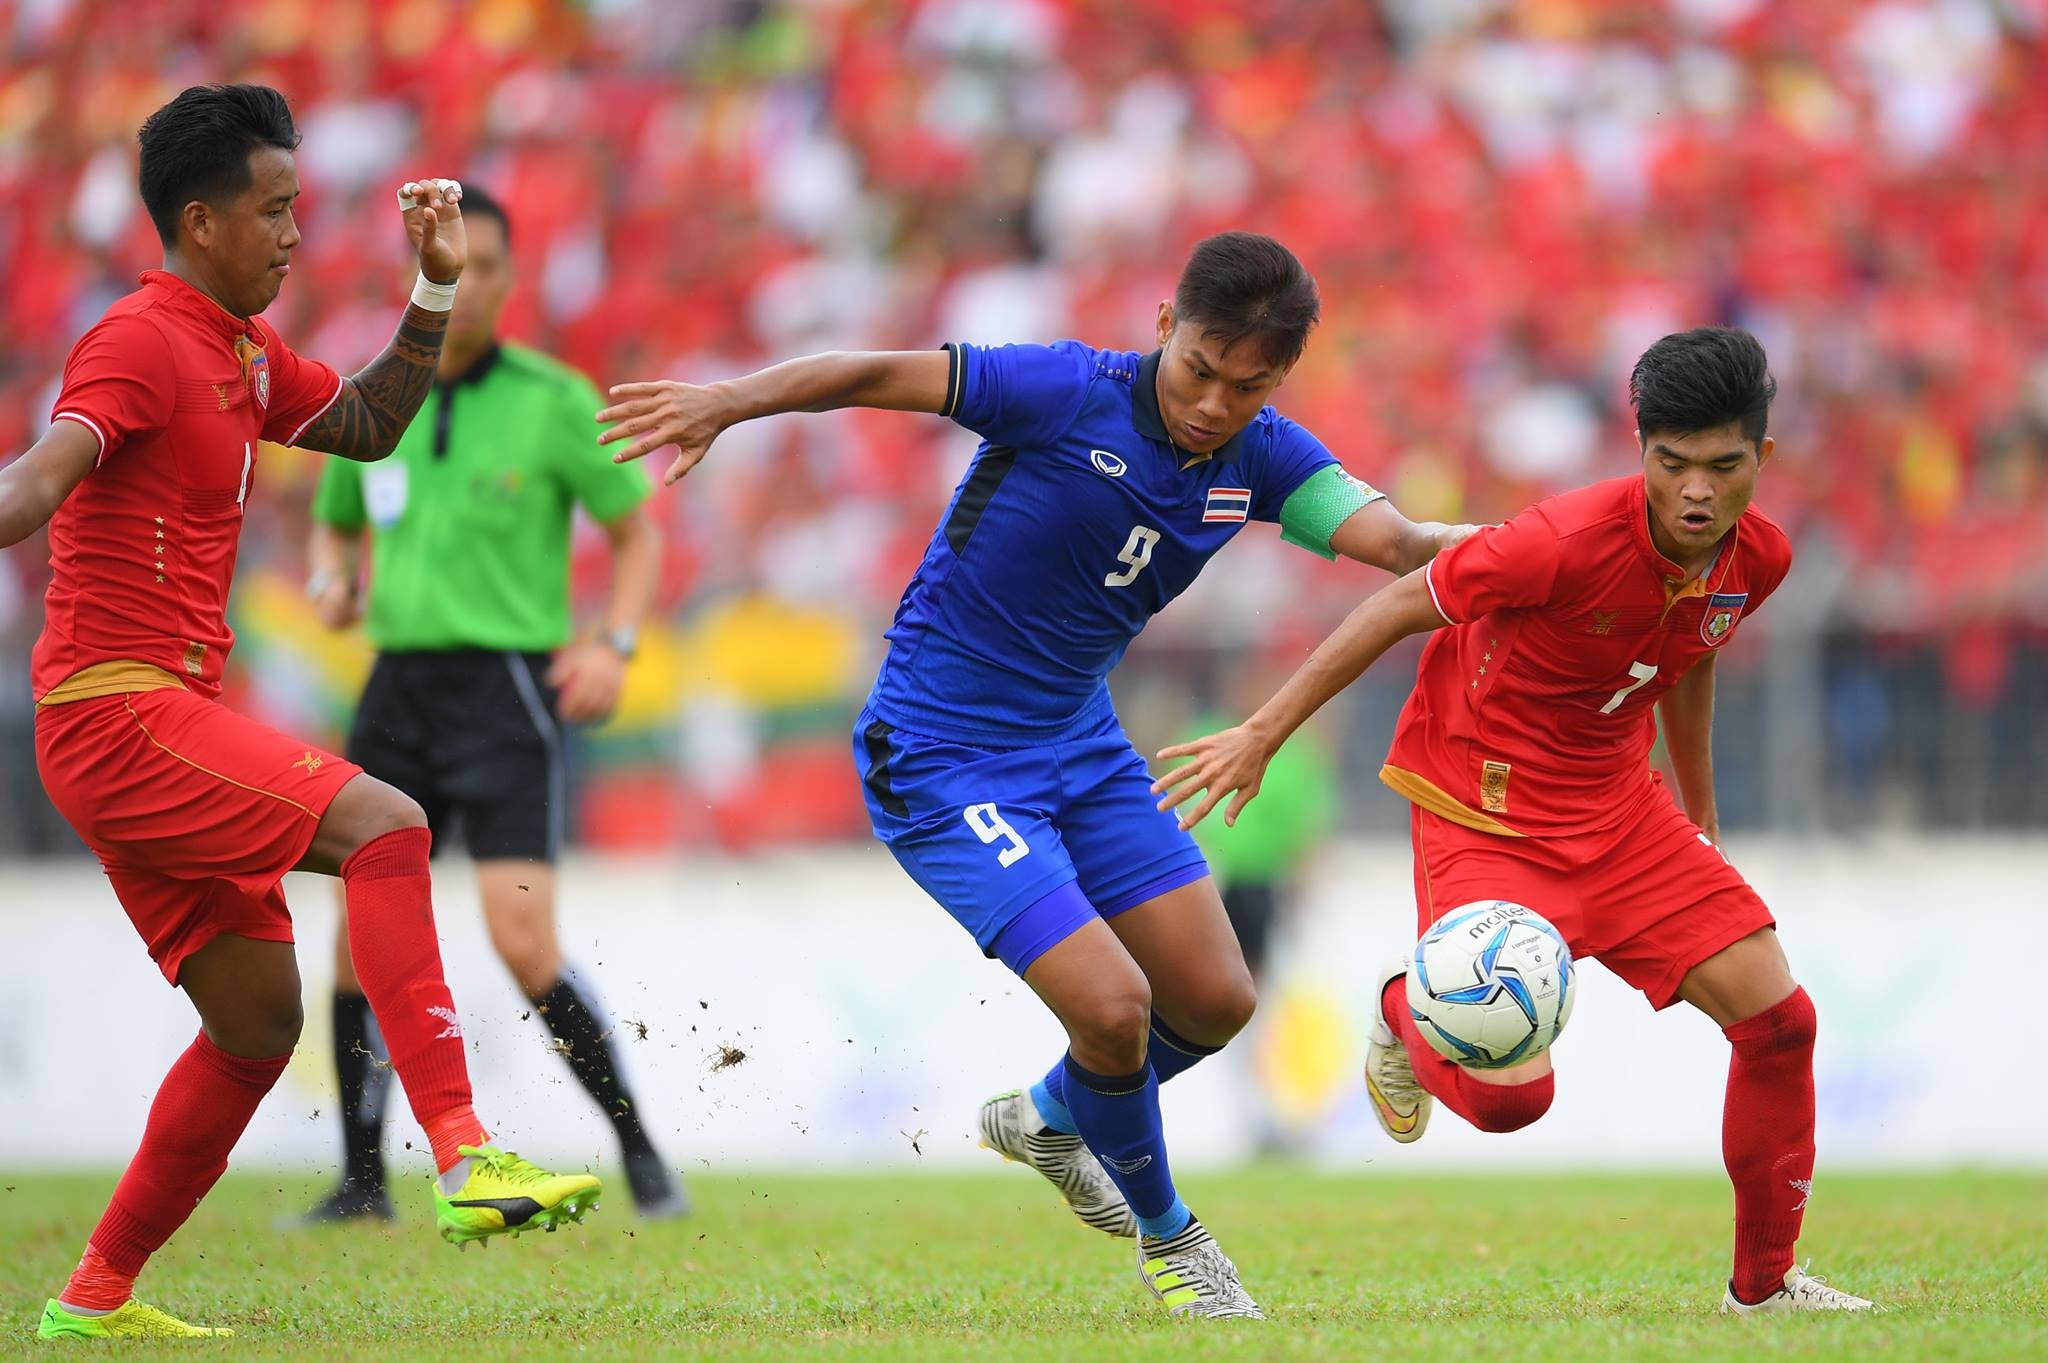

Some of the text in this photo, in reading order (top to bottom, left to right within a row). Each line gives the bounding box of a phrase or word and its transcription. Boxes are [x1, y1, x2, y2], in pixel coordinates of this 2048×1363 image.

[1104, 525, 1161, 587] 9
[1599, 660, 1658, 715] 7
[963, 802, 1030, 869] 9
